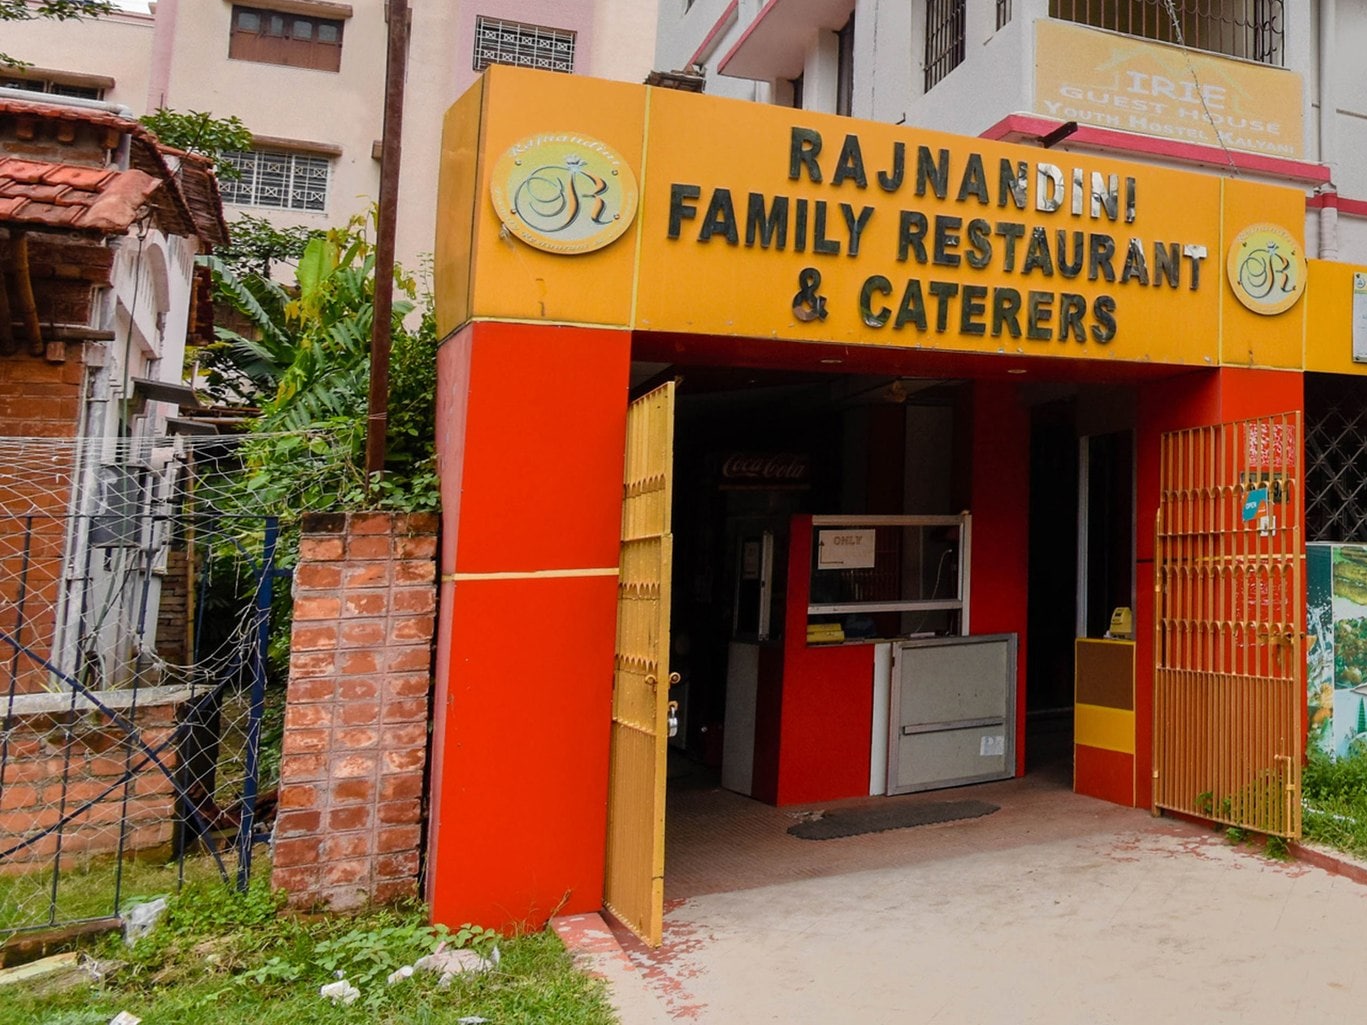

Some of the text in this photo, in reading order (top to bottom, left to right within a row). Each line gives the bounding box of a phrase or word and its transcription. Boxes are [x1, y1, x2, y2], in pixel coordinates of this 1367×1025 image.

[1058, 84, 1281, 137] GUEST HOUSE
[1126, 70, 1227, 110] IRIE
[1044, 99, 1295, 155] YOUTH HOSTEL KALYANI
[788, 126, 1136, 224] RAJNANDINI
[667, 183, 875, 257] FAMILY
[896, 209, 1208, 292] RESTAURANT
[792, 267, 1118, 344] & CATERERS
[833, 535, 863, 547] ONLY
